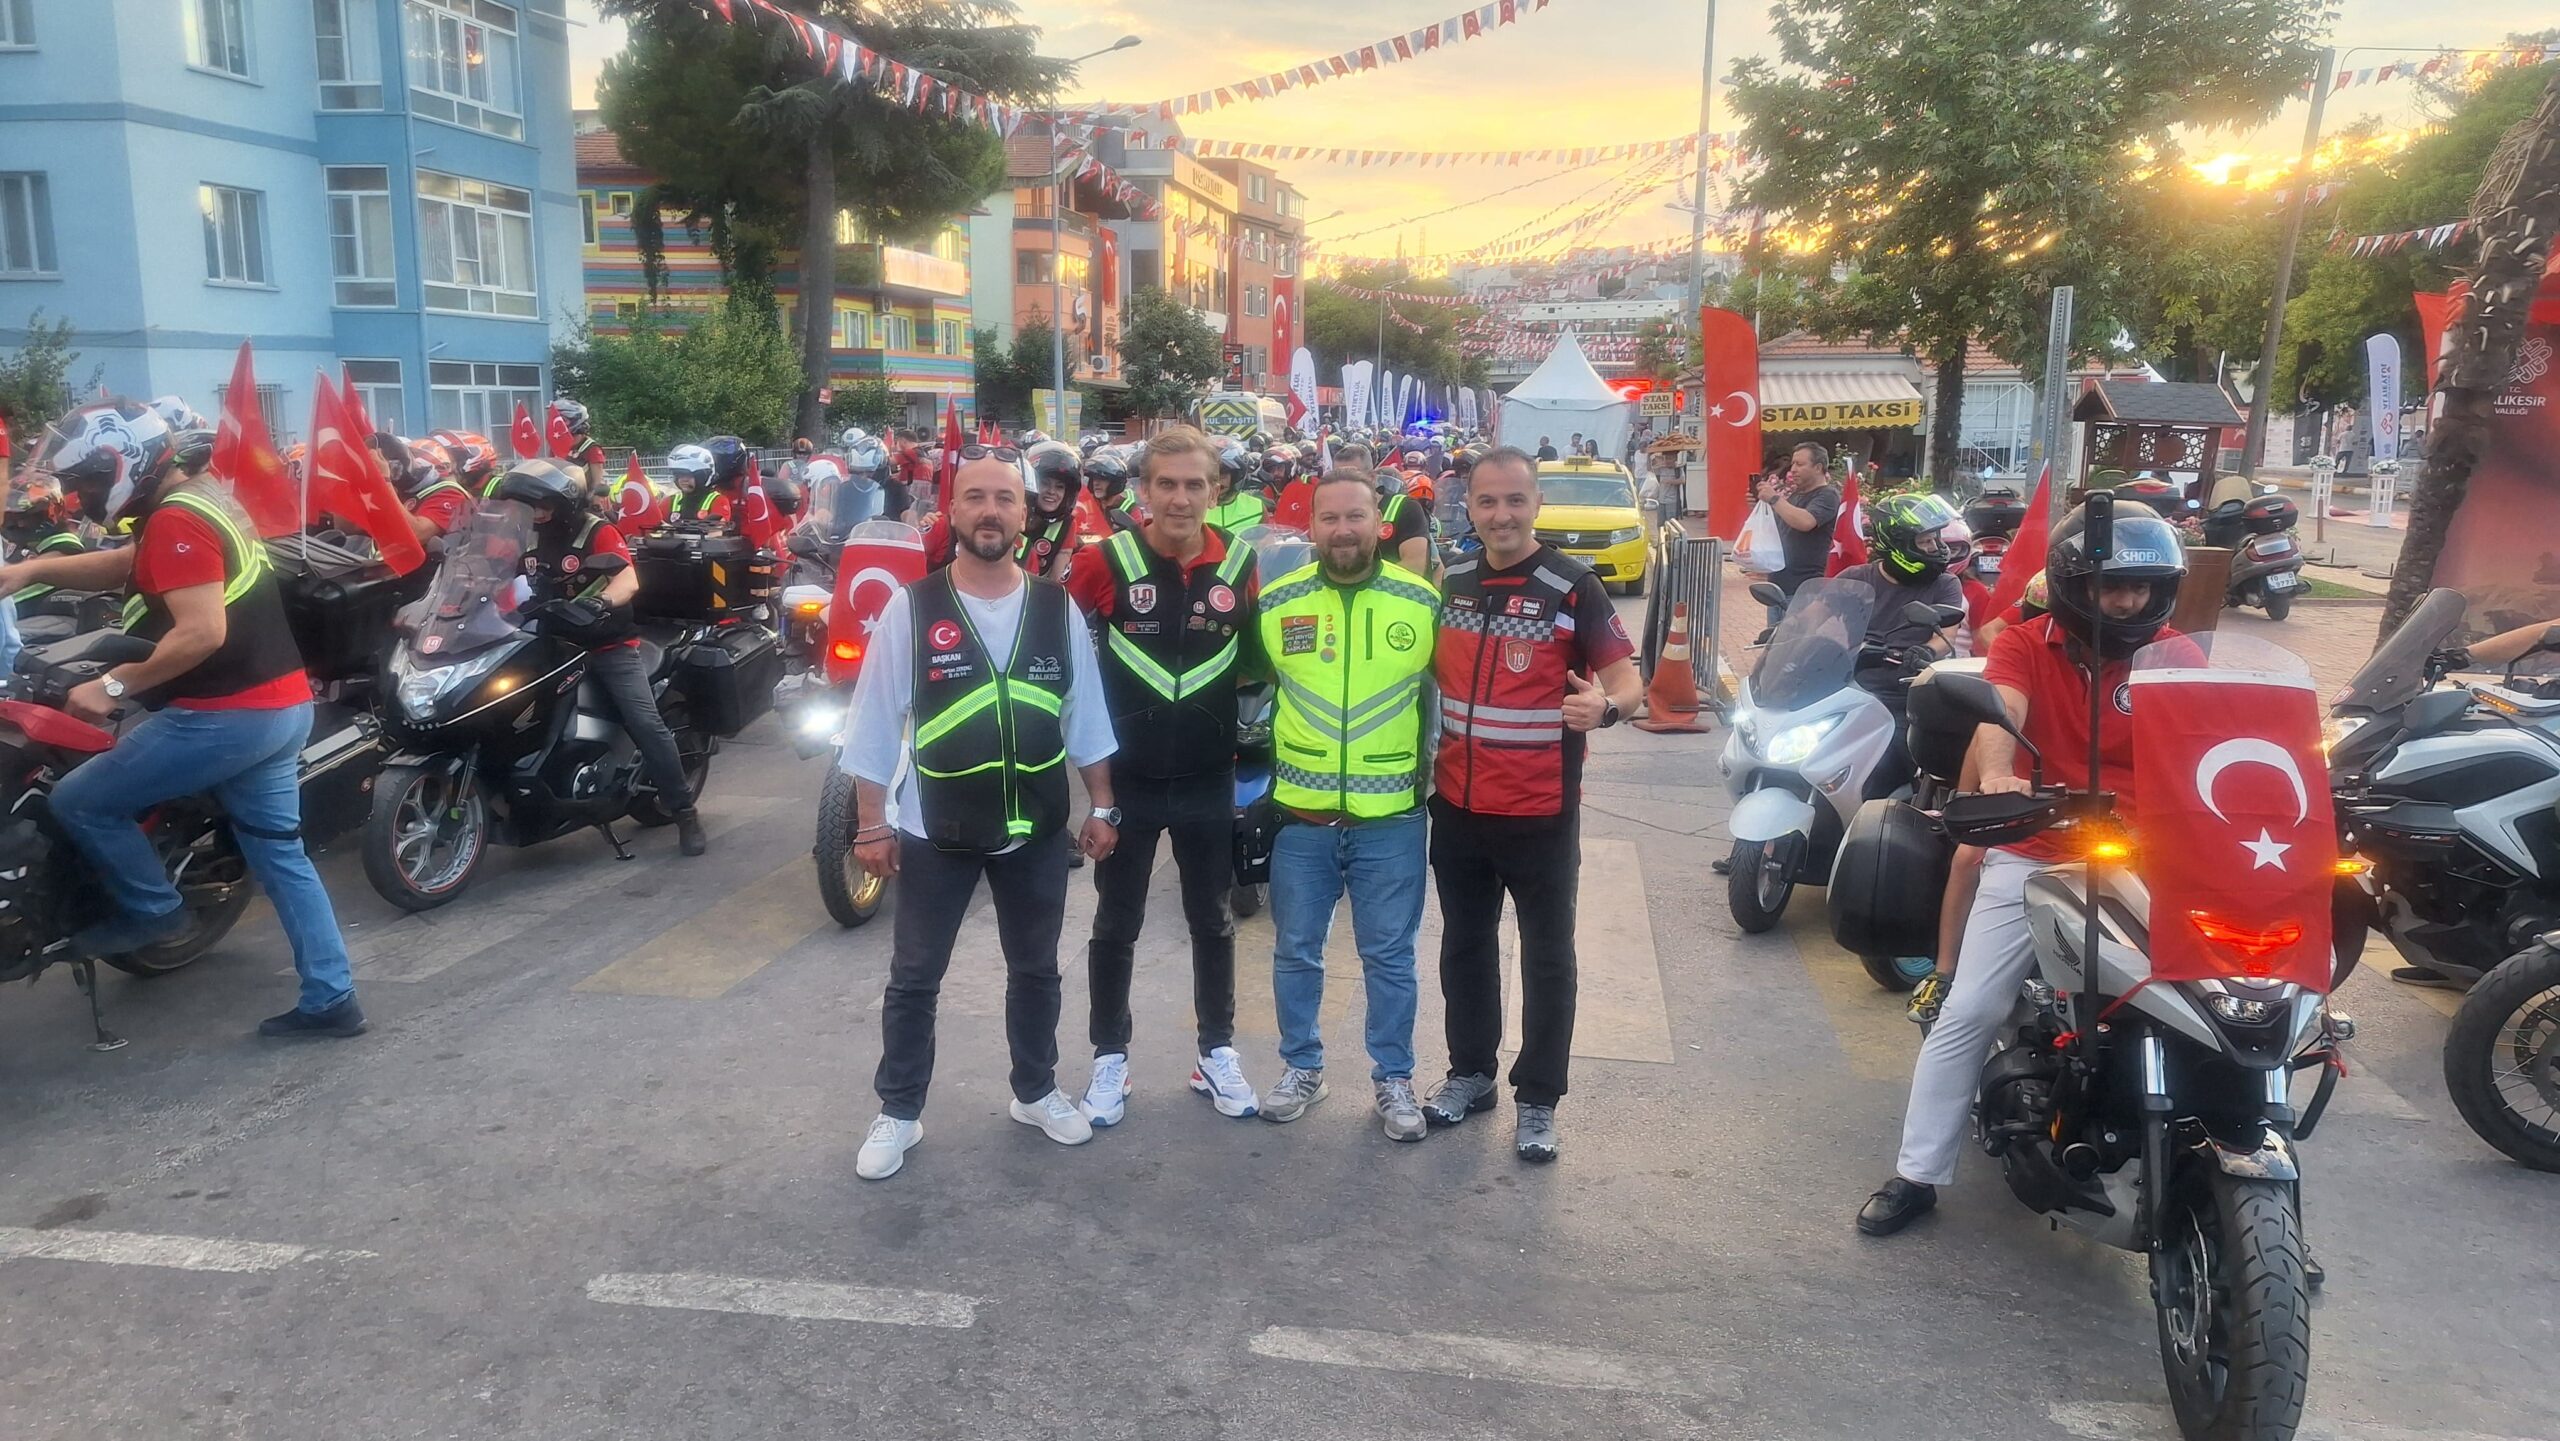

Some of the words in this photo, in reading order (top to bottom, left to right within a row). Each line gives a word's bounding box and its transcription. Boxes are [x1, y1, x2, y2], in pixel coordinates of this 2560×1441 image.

[1643, 394, 1670, 402] STAD
[1762, 406, 1827, 422] STAD
[1204, 416, 1220, 425] KUL
[2122, 550, 2156, 562] SHOEI
[931, 653, 961, 664] BAŞKAN
[1513, 652, 1525, 666] 10
